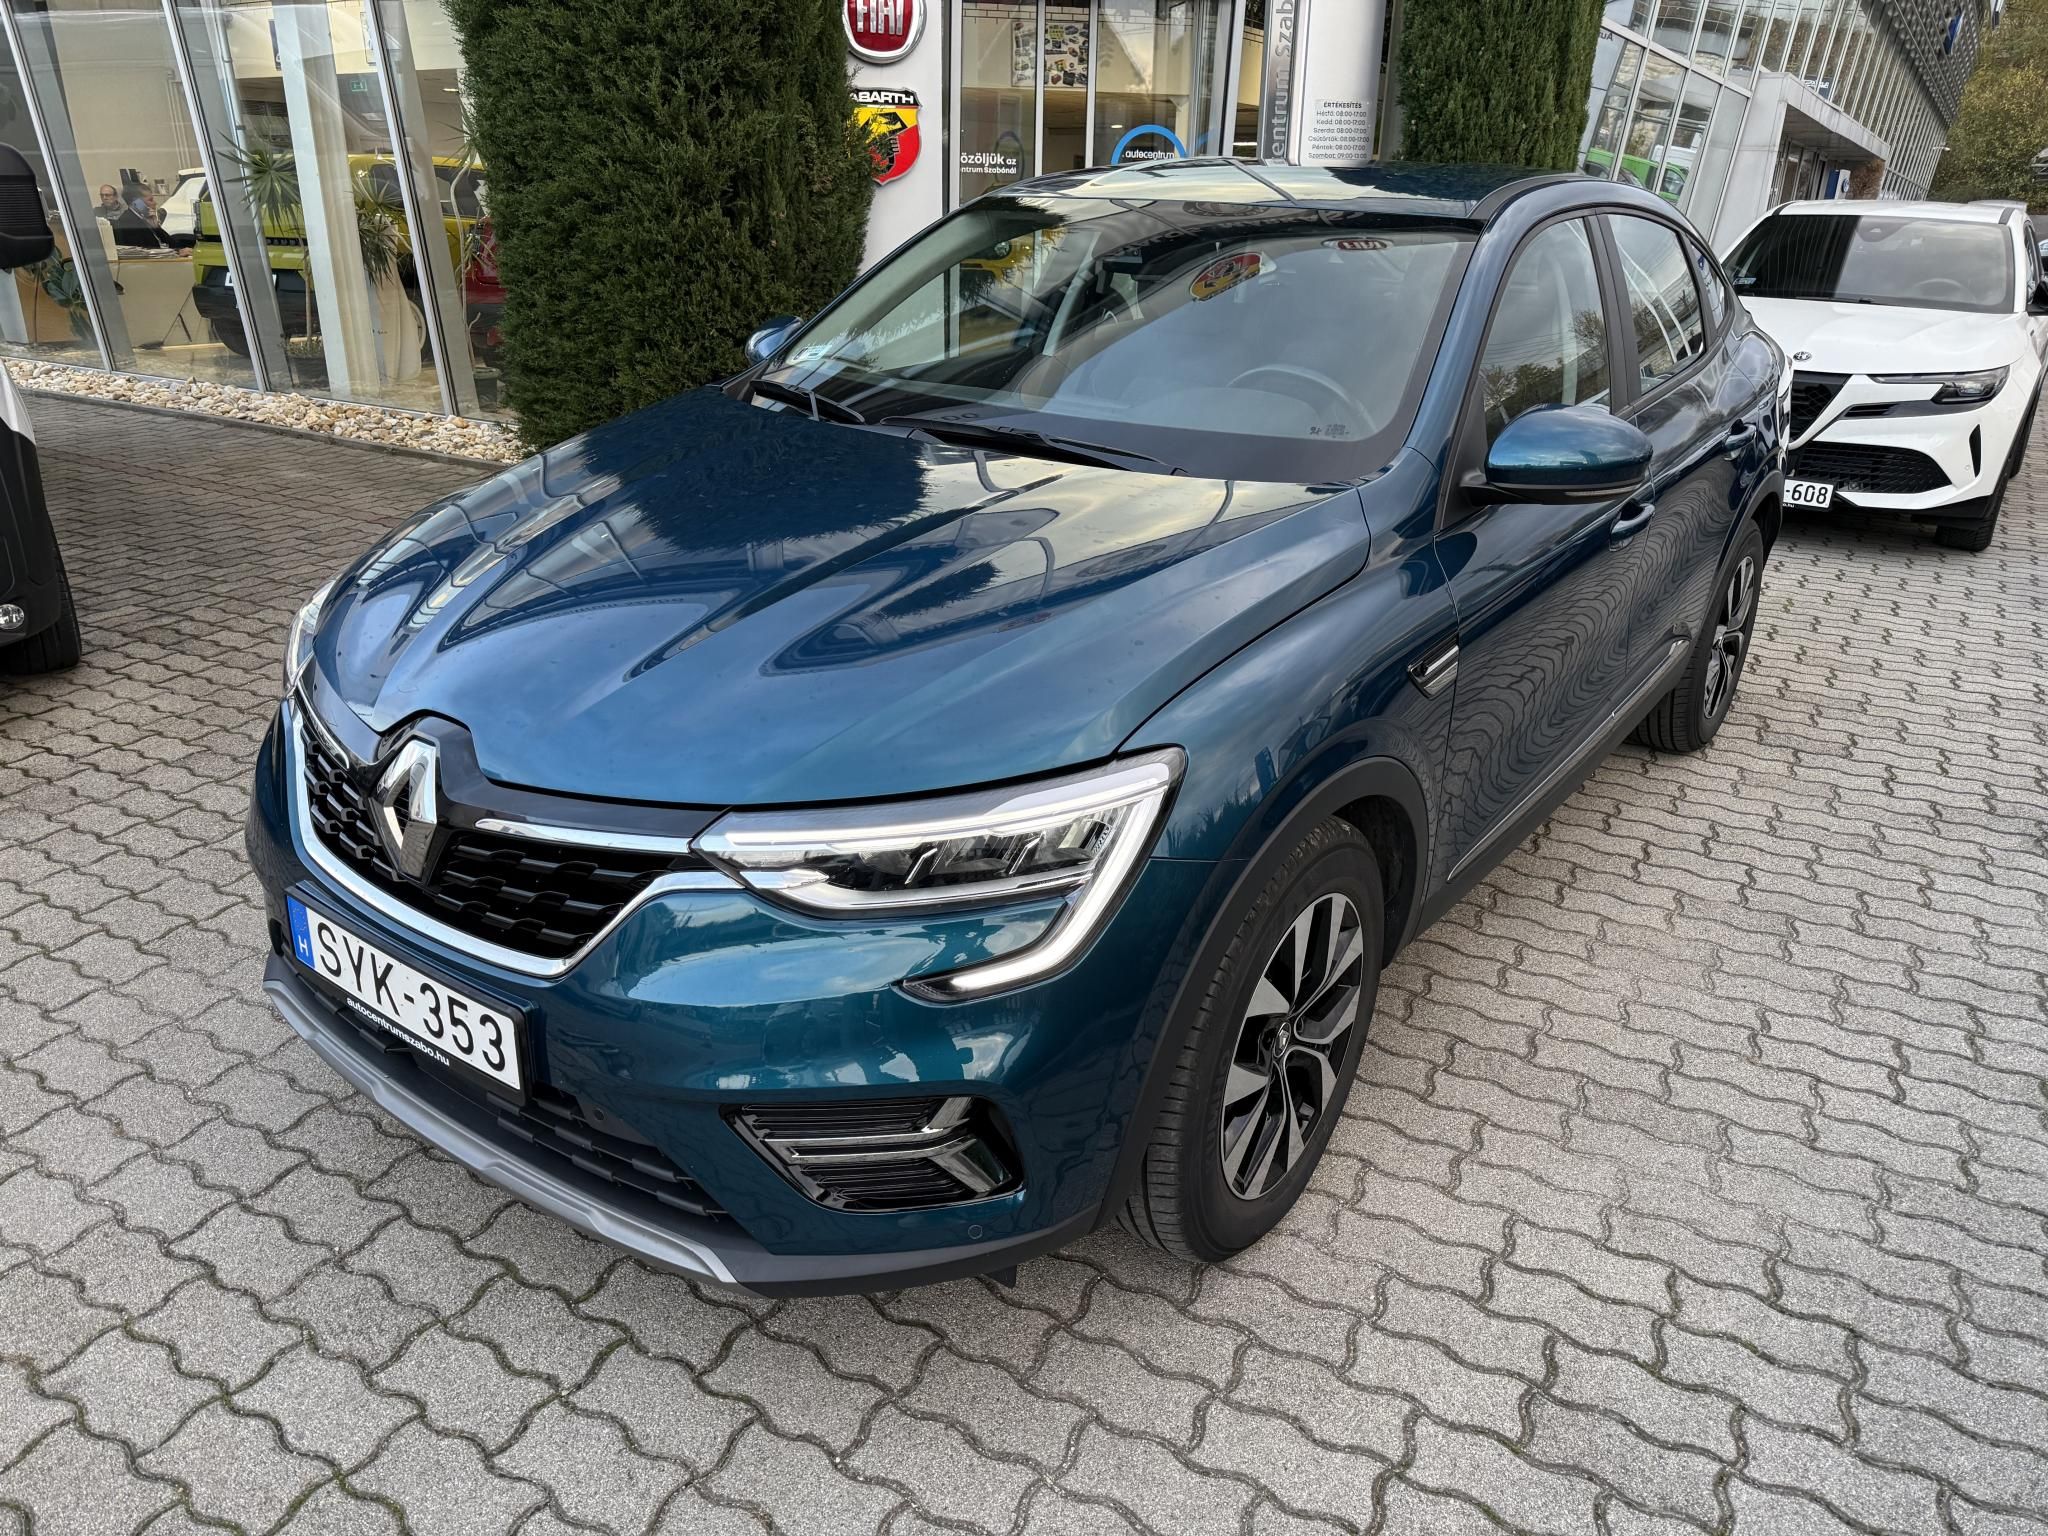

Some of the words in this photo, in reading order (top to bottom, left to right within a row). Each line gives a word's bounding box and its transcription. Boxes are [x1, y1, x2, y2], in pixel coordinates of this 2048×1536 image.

[856, 0, 905, 35] FIAT
[849, 91, 914, 104] ABARTH
[1125, 149, 1175, 160] autocentrum
[298, 934, 309, 957] H
[317, 922, 506, 1073] SYK-353
[346, 997, 450, 1067] autocentrumszabo.hu
